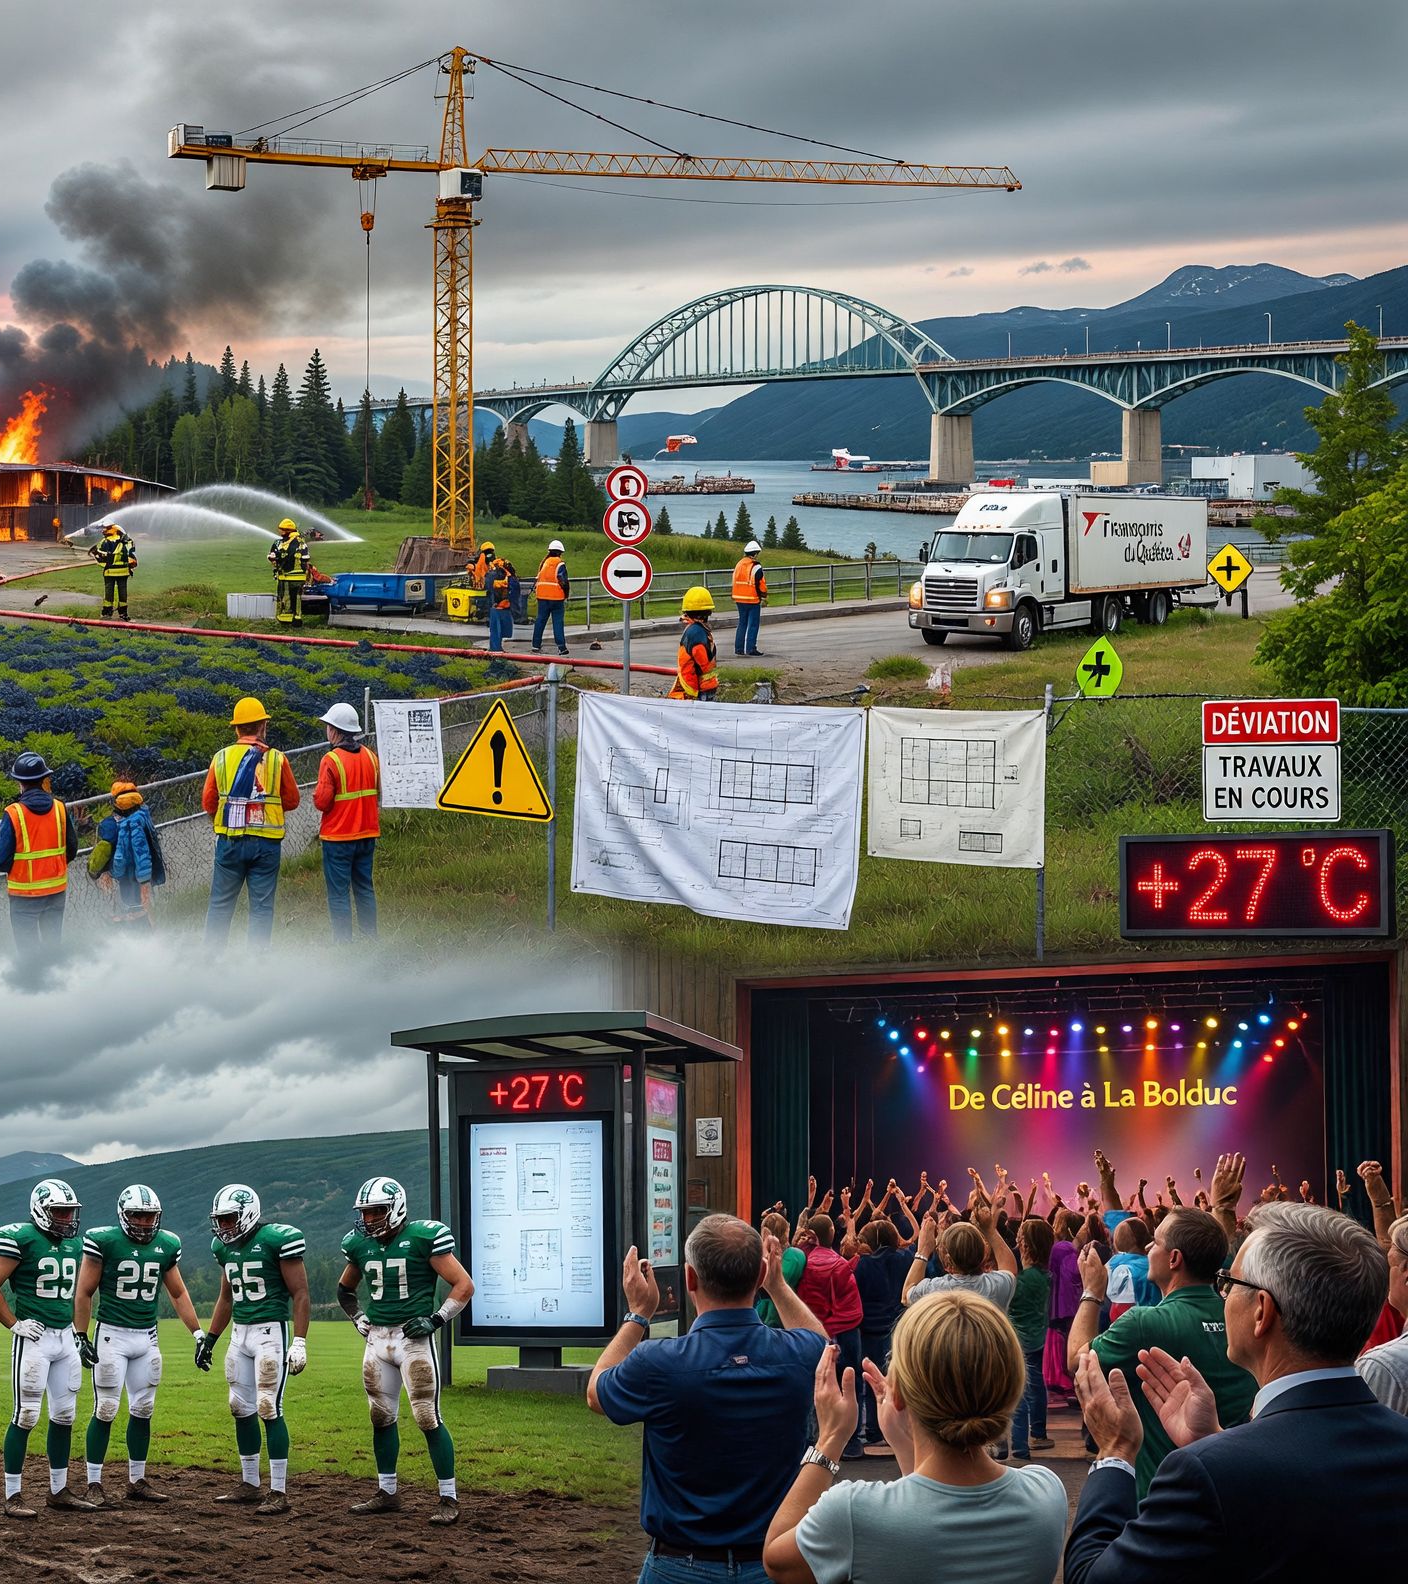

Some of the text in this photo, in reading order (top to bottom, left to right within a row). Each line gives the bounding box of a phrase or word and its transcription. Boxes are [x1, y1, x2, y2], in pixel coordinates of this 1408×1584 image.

[1212, 707, 1330, 735] DÉVIATION
[1219, 755, 1322, 778] TRAVAUX
[1214, 786, 1329, 809] EN COURS
[949, 1078, 1238, 1111] De Céline à La Bolduc
[36, 1256, 77, 1300] 29
[116, 1260, 161, 1301] 25
[224, 1260, 267, 1301] 65
[364, 1257, 410, 1300] 37
